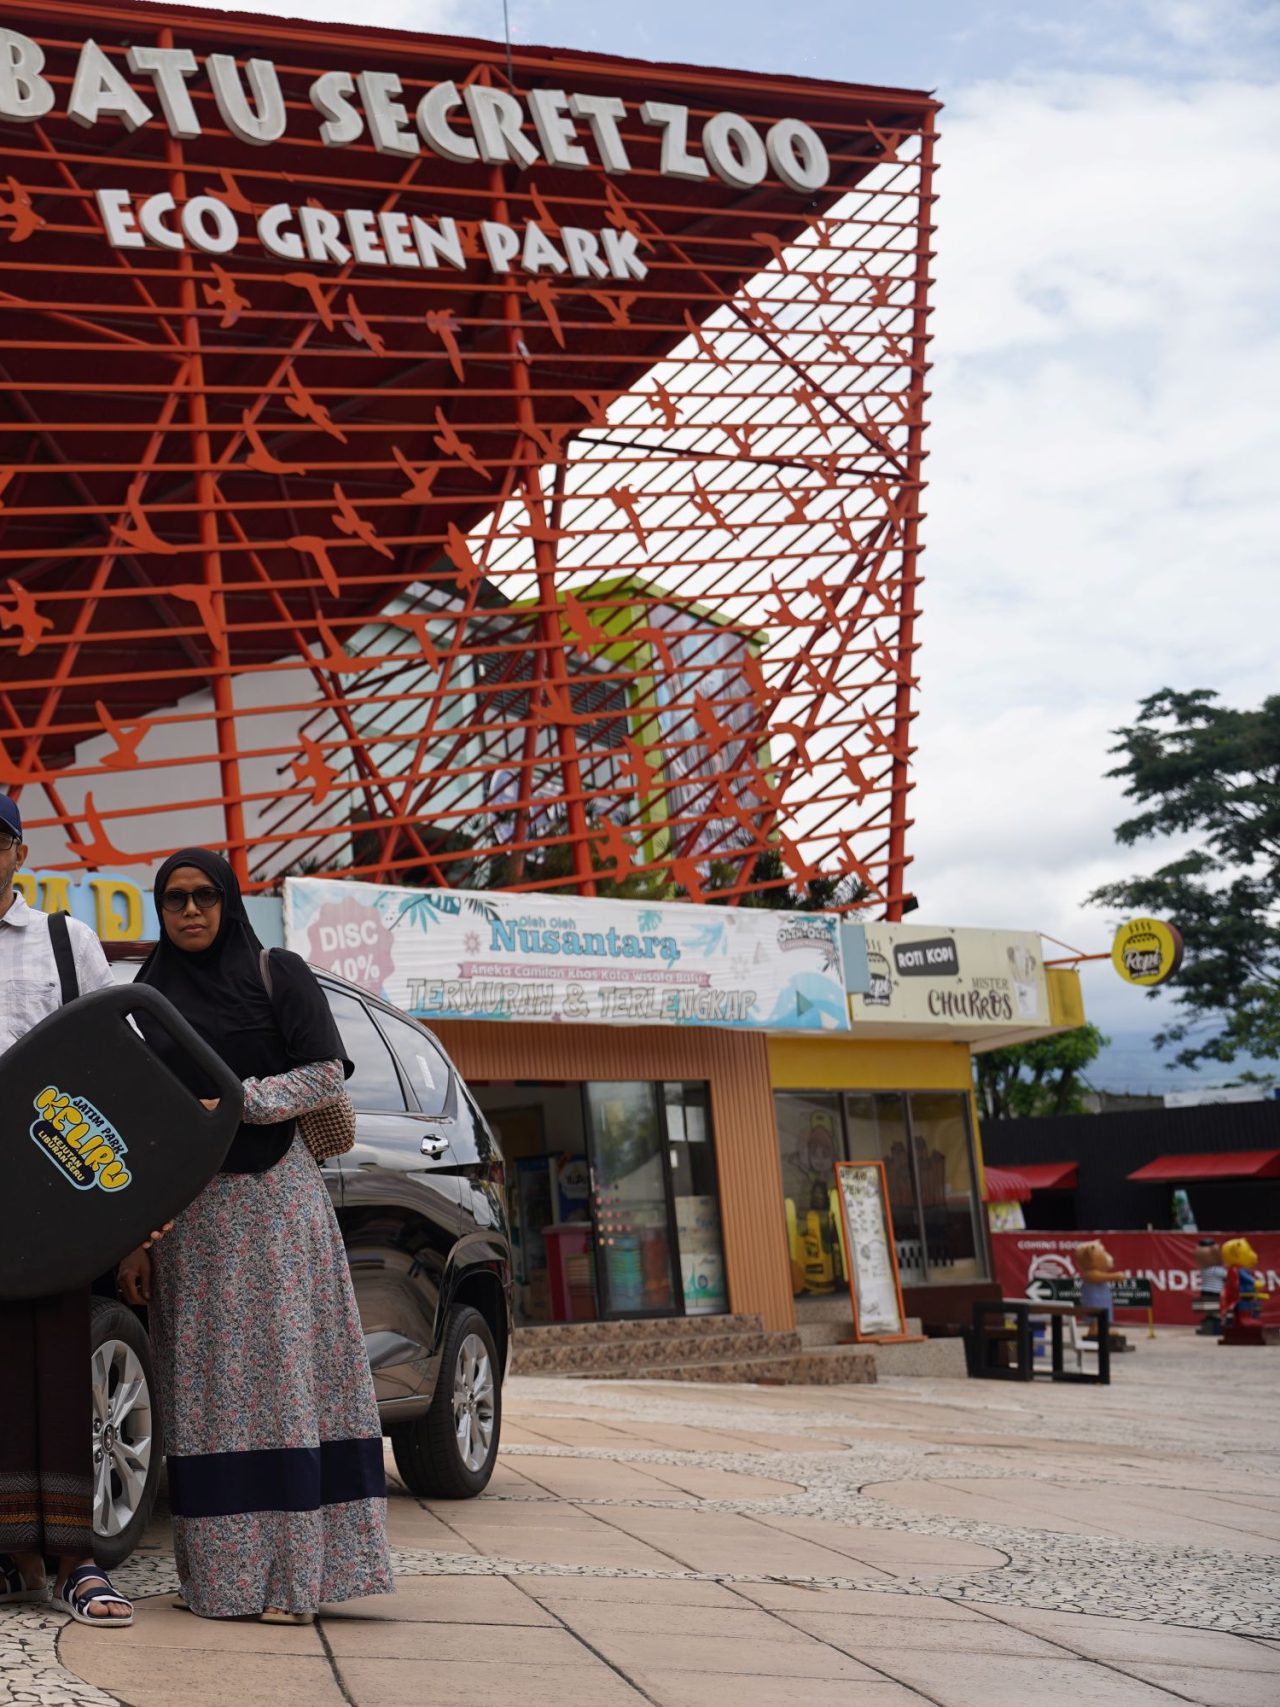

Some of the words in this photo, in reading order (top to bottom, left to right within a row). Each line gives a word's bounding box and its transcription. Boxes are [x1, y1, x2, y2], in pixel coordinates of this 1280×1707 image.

[308, 70, 633, 176] SECRET
[639, 100, 832, 194] ZOO
[93, 188, 240, 256] ECO
[257, 203, 466, 273] GREEN
[479, 220, 649, 282] PARK
[320, 920, 379, 952] DISC
[519, 915, 546, 928] Oleh
[549, 917, 576, 930] Oleh
[489, 919, 681, 966] Nusantara
[897, 951, 924, 968] ROTI
[927, 946, 954, 964] KOPI
[330, 953, 381, 982] 10%
[471, 963, 511, 976] Aneka
[514, 966, 564, 979] Camilan
[569, 966, 599, 981] Khas
[601, 968, 628, 981] Kota
[406, 978, 555, 1018] TERMURAH
[562, 983, 591, 1018] &
[598, 985, 757, 1022] TERLENGKAP
[972, 977, 1009, 991] MISTER
[927, 989, 1013, 1020] CHURROS
[36, 1088, 129, 1188] KELIRU
[72, 1099, 105, 1128] JATIM
[101, 1127, 125, 1155] PARK
[38, 1130, 69, 1163] LIBURAN
[65, 1160, 85, 1181] SERU
[51, 1135, 82, 1168] KEJUTAN
[1125, 1269, 1202, 1292] NDE
